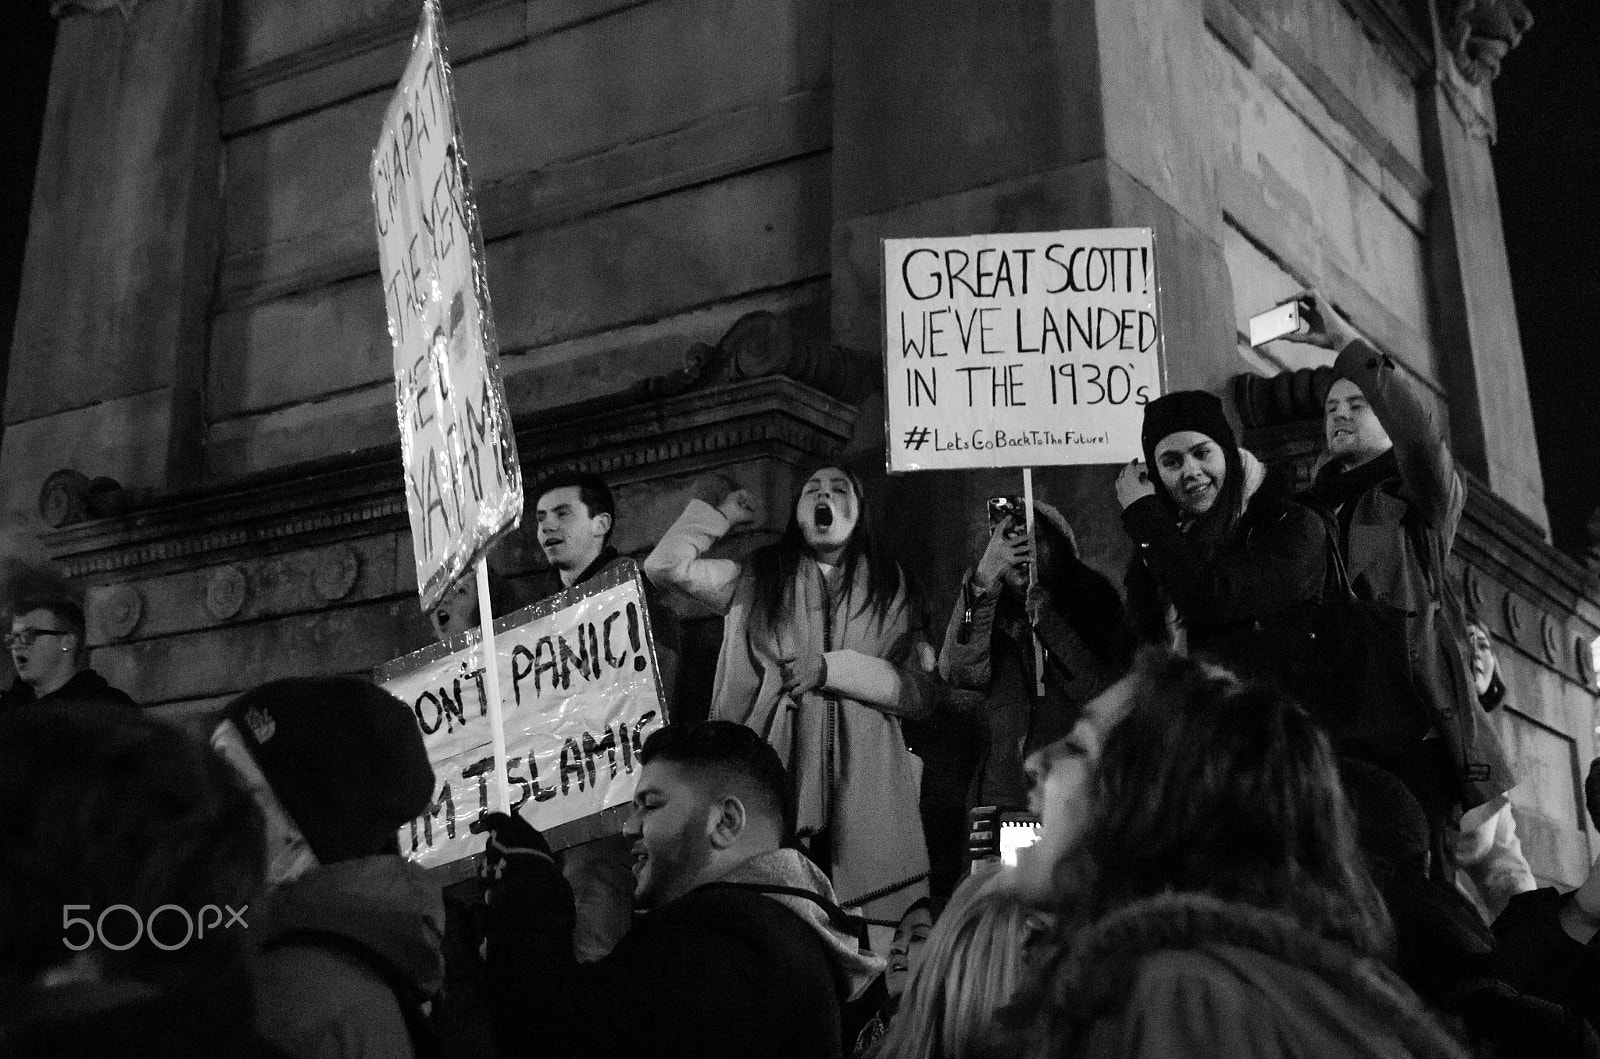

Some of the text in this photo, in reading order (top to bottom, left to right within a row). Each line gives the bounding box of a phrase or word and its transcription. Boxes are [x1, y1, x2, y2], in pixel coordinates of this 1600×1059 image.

[902, 243, 1148, 300] GREAT SCOTT!
[901, 305, 1157, 359] WE'VE LANDED
[906, 362, 1149, 407] IN THE 1930's
[414, 601, 647, 735] ON'T PANIC!
